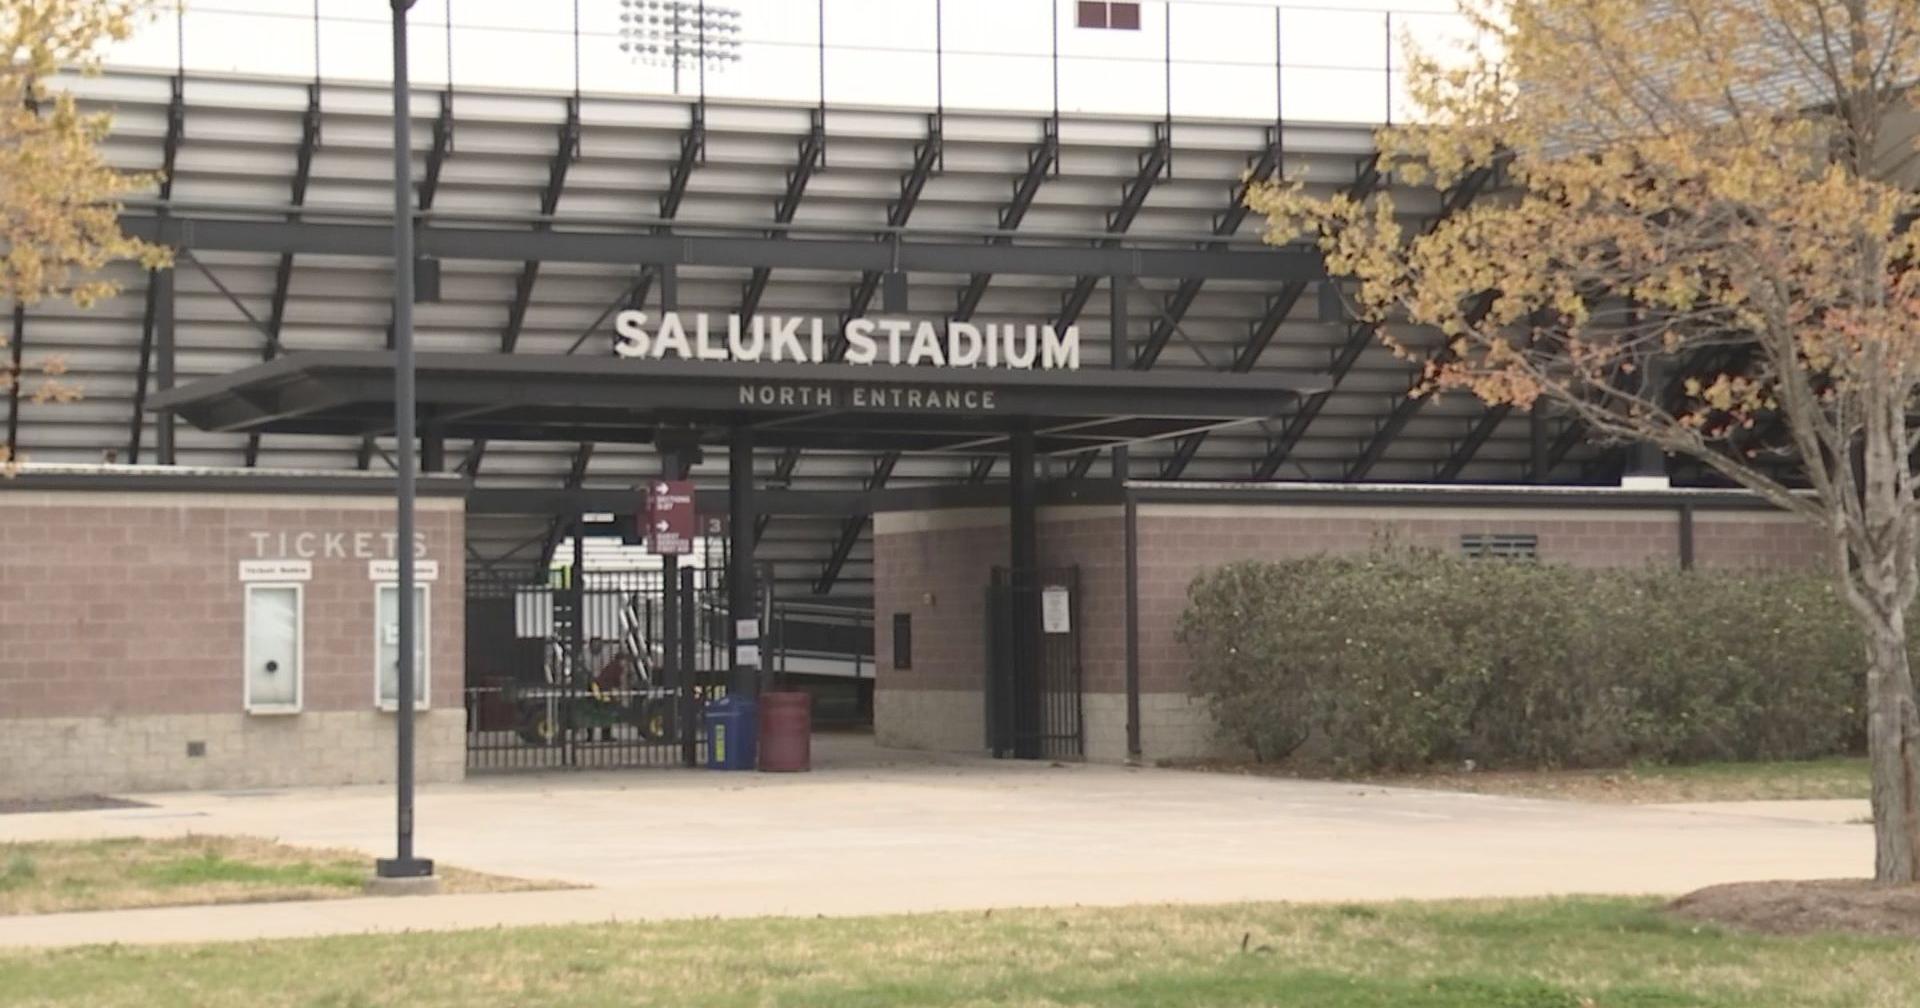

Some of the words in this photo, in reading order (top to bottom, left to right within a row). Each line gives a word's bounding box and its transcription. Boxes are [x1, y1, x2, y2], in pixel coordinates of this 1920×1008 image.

[615, 309, 824, 362] SALUKI
[844, 318, 1080, 370] STADIUM
[739, 385, 832, 407] NORTH
[853, 388, 996, 409] ENTRANCE
[708, 517, 722, 534] 3
[250, 531, 427, 559] TICKETS
